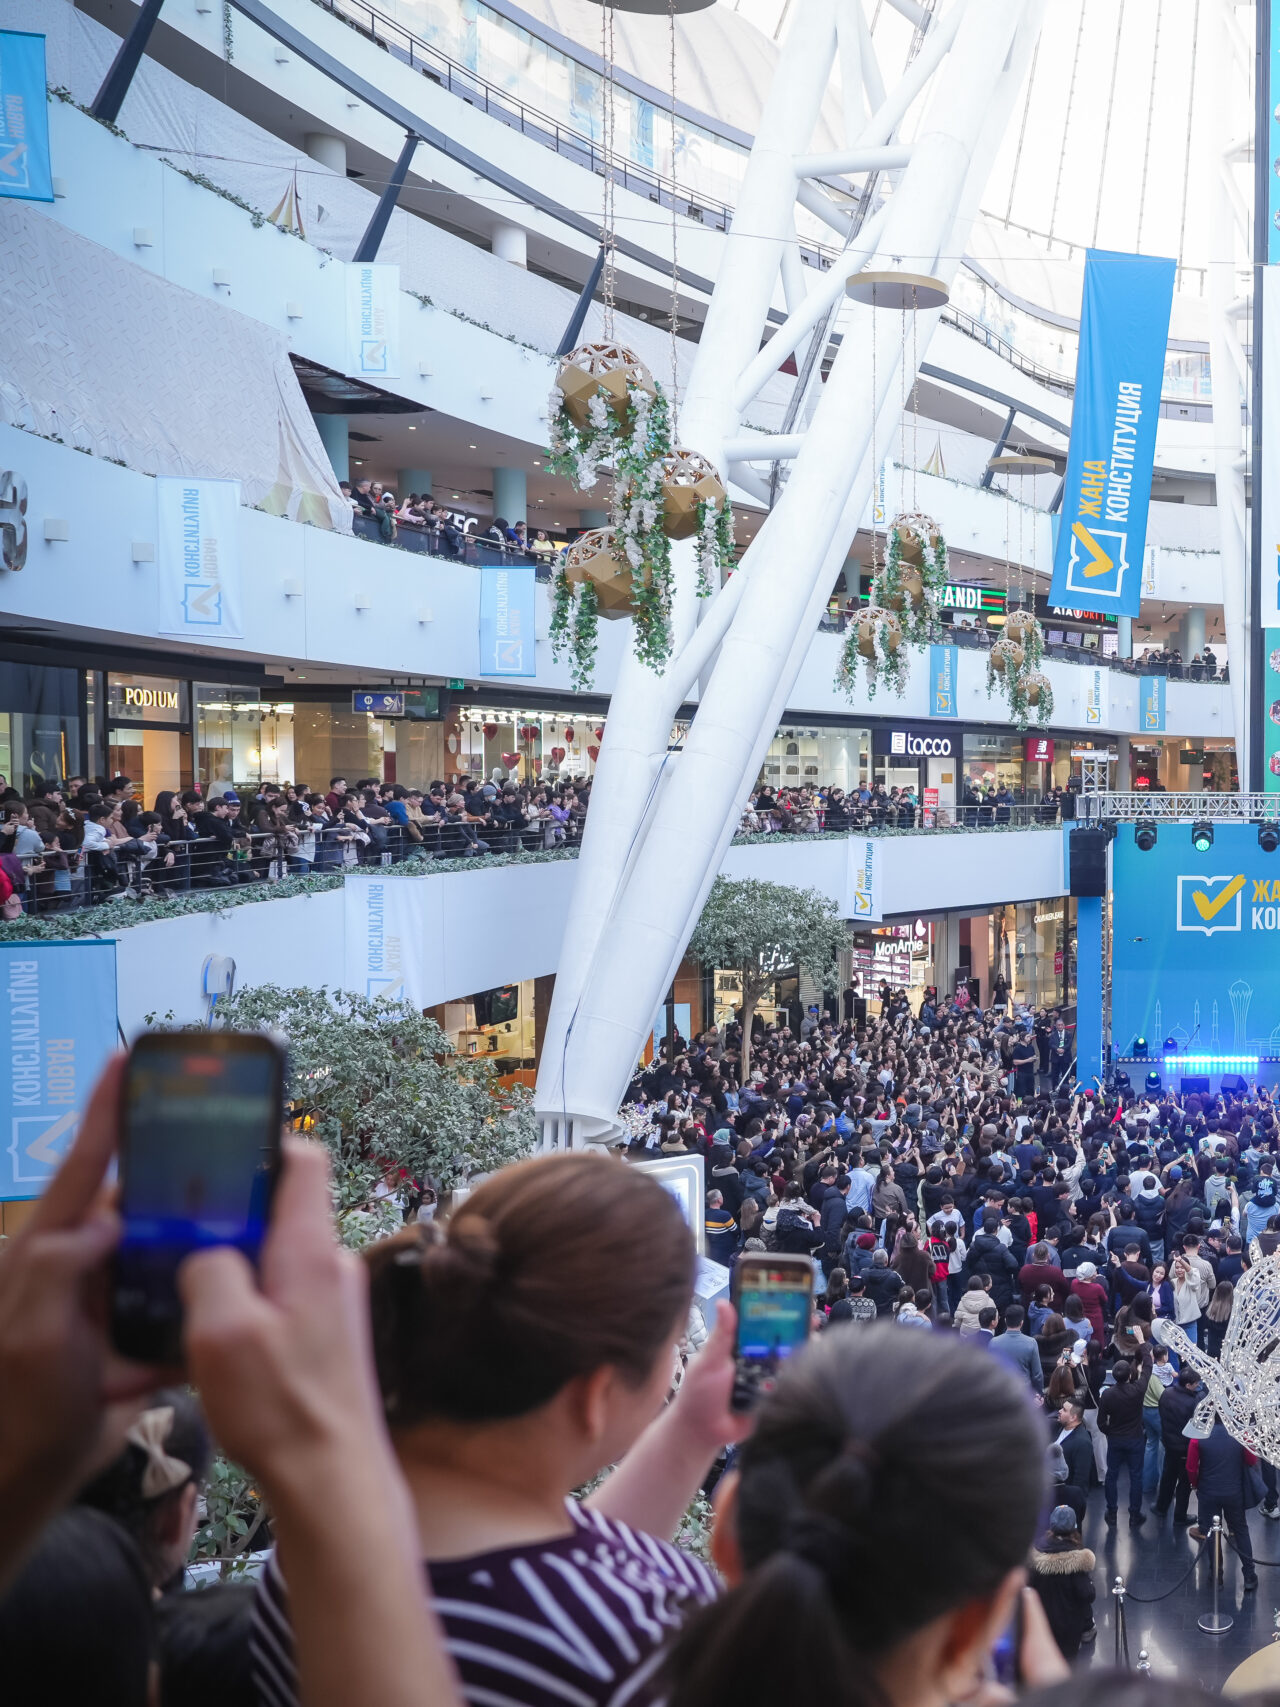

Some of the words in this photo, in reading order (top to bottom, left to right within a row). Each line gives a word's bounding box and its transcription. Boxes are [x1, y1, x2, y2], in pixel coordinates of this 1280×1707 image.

[1104, 382, 1143, 522] КОНСТИТУЦИЯ
[1078, 460, 1107, 518] ЖАҢА
[125, 687, 178, 709] PODIUM
[907, 732, 951, 756] tacco
[865, 842, 874, 891] КОНСТИТУЦИЯ
